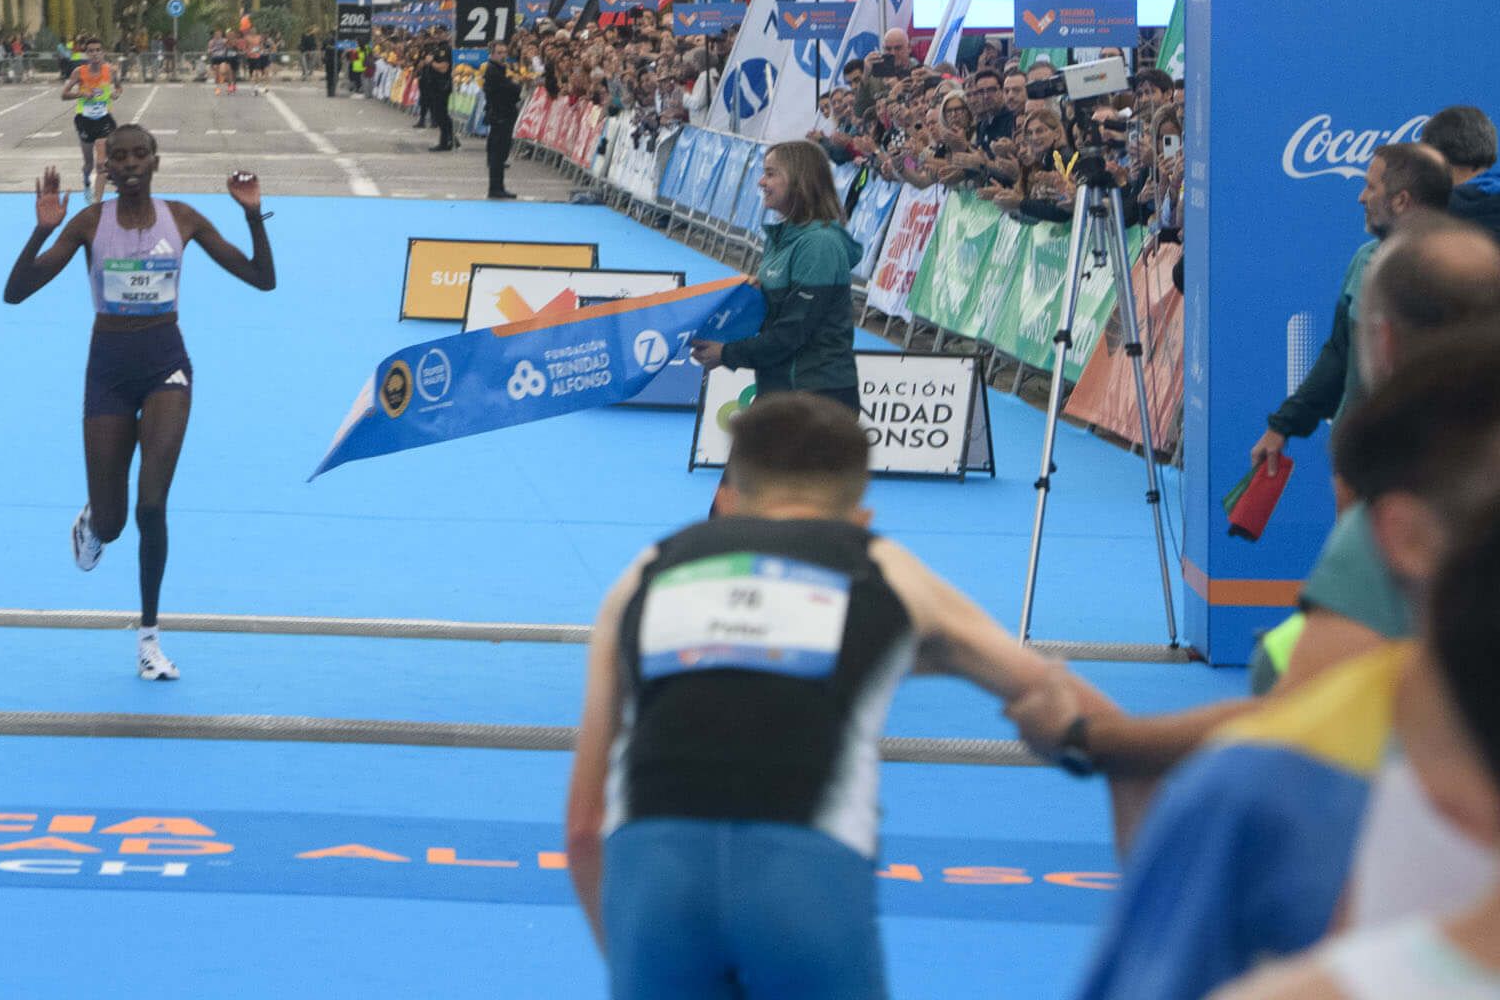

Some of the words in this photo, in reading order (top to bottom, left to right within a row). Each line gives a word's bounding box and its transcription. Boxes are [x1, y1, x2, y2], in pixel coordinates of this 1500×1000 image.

[340, 13, 365, 26] 200
[463, 6, 509, 42] 21
[547, 352, 611, 380] TRINIDAD
[551, 369, 613, 398] ALFONSO
[863, 380, 955, 397] DACIÓN
[860, 402, 953, 424] NIDAD
[865, 427, 949, 448] ONSO
